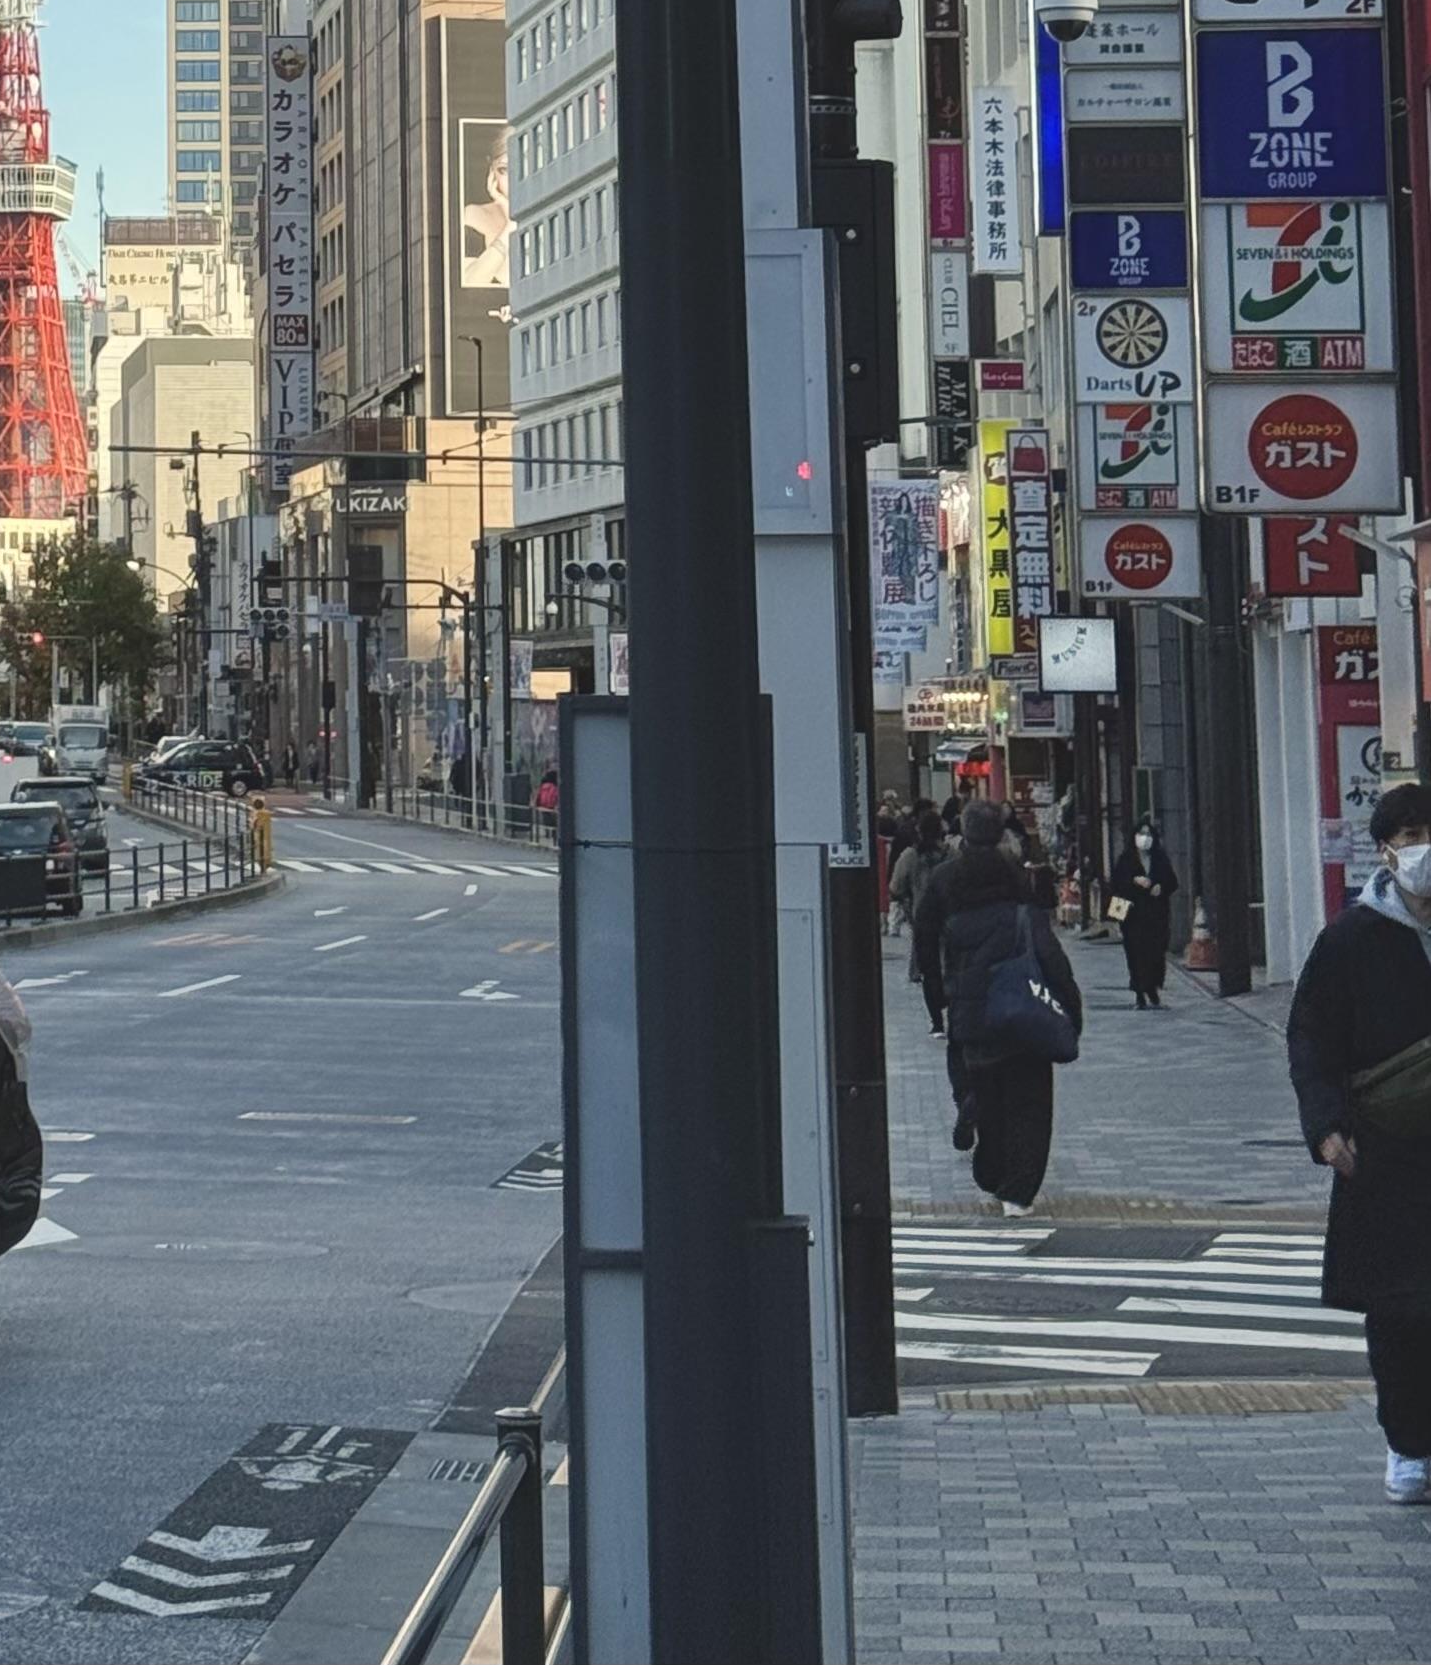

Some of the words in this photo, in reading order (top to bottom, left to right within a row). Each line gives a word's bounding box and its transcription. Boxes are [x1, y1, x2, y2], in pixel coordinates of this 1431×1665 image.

[1265, 40, 1315, 128] B
[272, 89, 296, 206] カラオケ
[297, 93, 308, 200] KARAOKE
[1248, 132, 1335, 168] ZONE
[983, 97, 1008, 261] 六本木法律事務所
[1267, 171, 1318, 189] GROUP
[272, 221, 296, 308] パセラ
[299, 226, 308, 304] PASELA
[1109, 257, 1150, 276] ZONE
[1291, 247, 1355, 261] HOLDINGS
[276, 316, 305, 328] MAX
[940, 287, 960, 337] CIEL
[1233, 340, 1276, 366] たばこ
[1284, 339, 1312, 368] 酒
[1321, 340, 1363, 368] ATM
[938, 366, 953, 413] HAIR
[1085, 376, 1132, 393] Darts
[1134, 371, 1182, 399] UP
[1264, 439, 1347, 469] ガスト
[1151, 490, 1178, 507] ATM
[1216, 485, 1260, 505] B1F
[1013, 481, 1051, 619] 査定無料
[1114, 552, 1167, 572] ガスト
